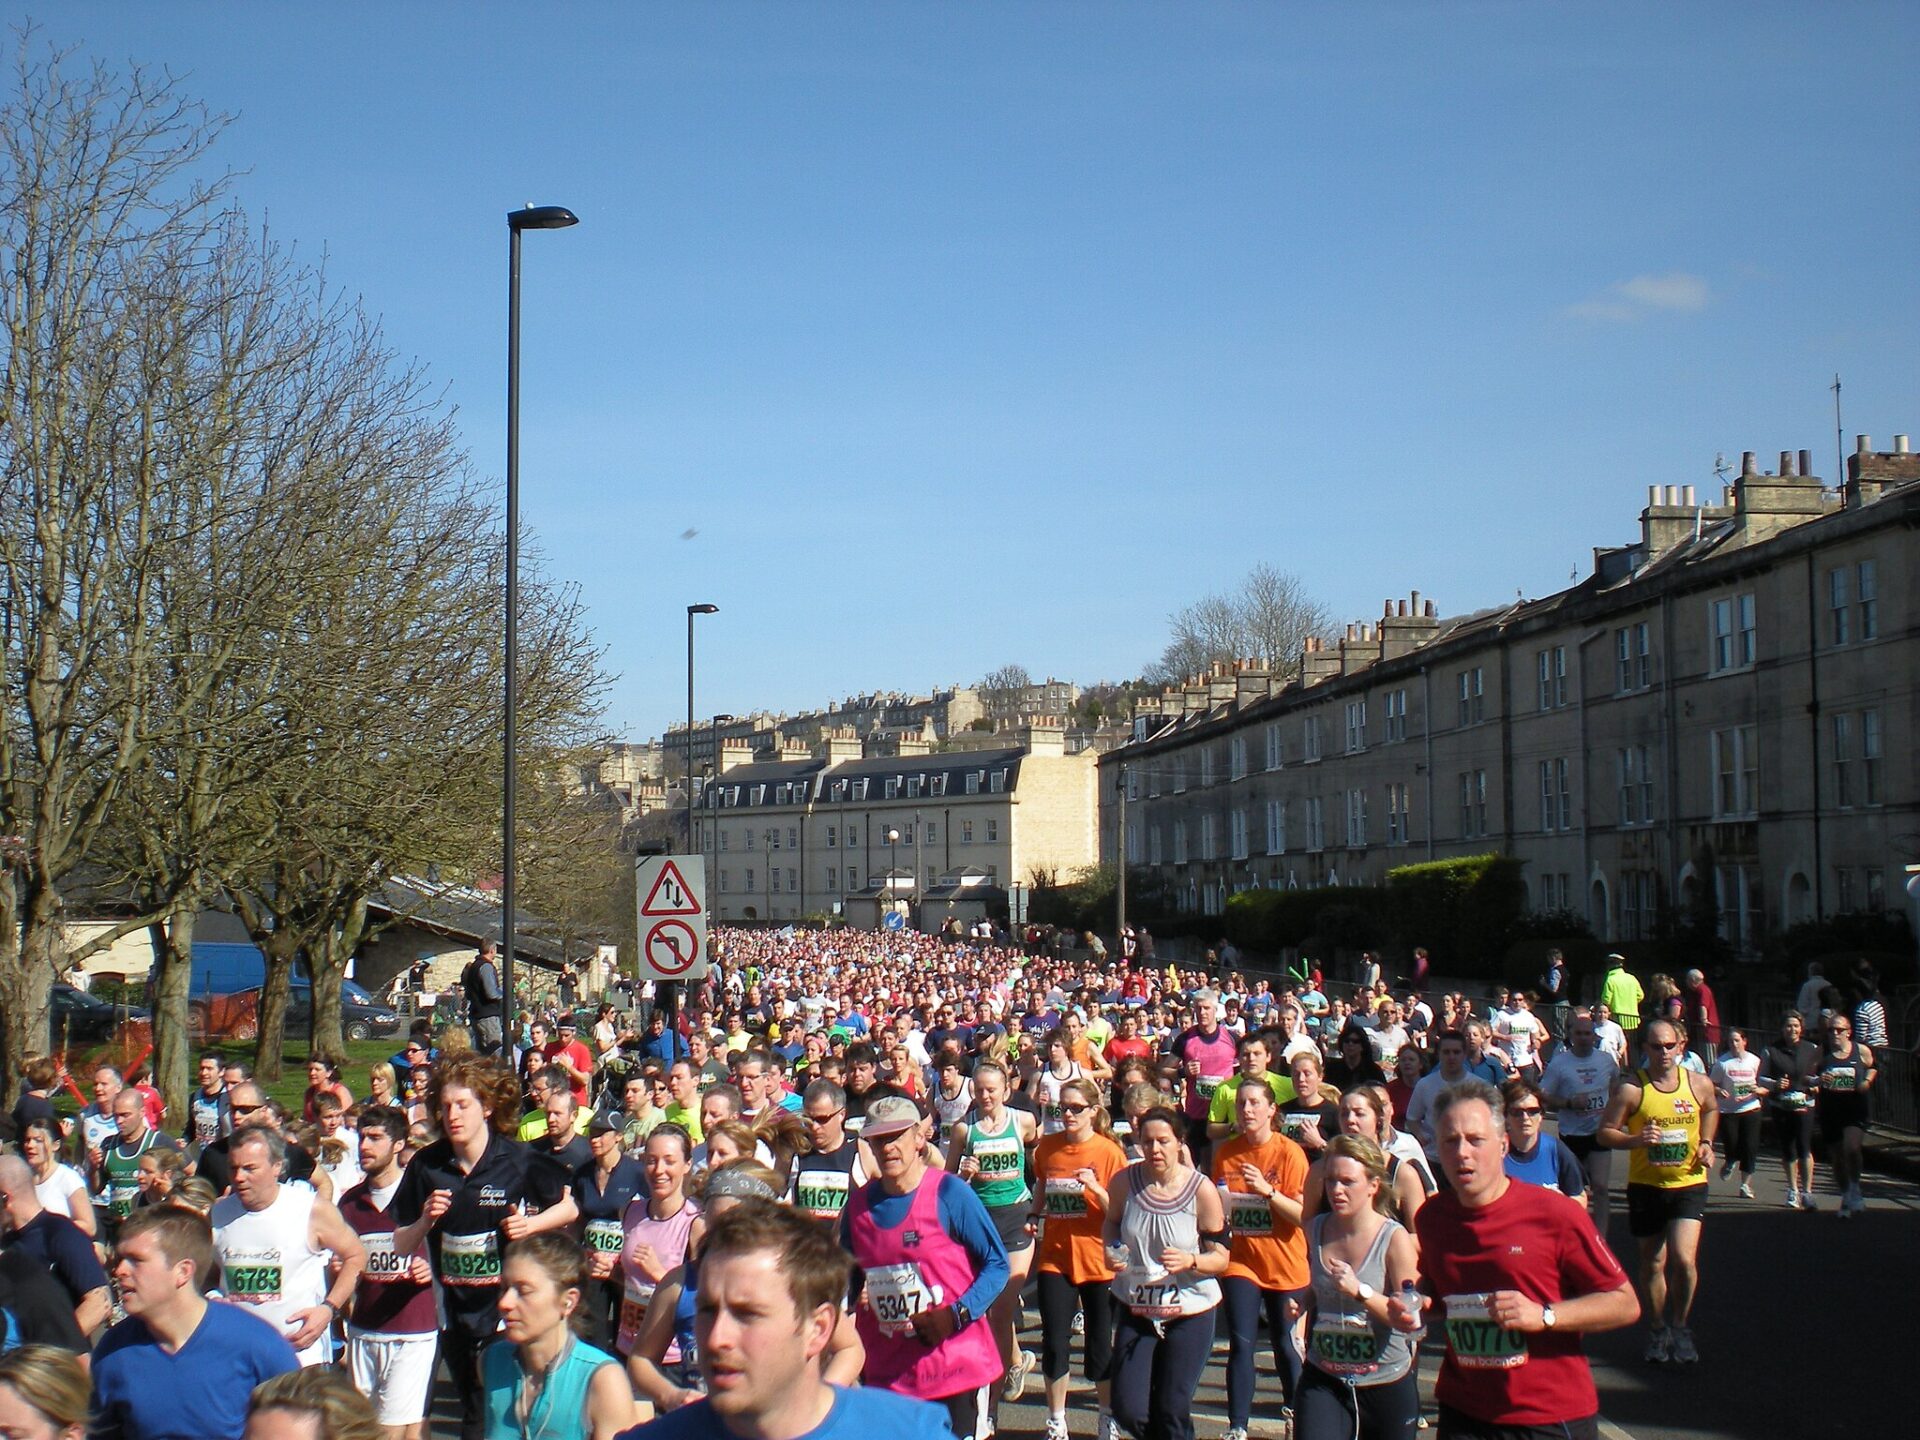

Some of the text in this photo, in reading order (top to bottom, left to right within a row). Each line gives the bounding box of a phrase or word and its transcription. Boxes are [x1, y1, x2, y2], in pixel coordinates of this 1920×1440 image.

[1046, 1194, 1088, 1211] 14125
[234, 1268, 281, 1290] 6783
[877, 1291, 920, 1320] 5347
[1479, 1355, 1525, 1368] balance
